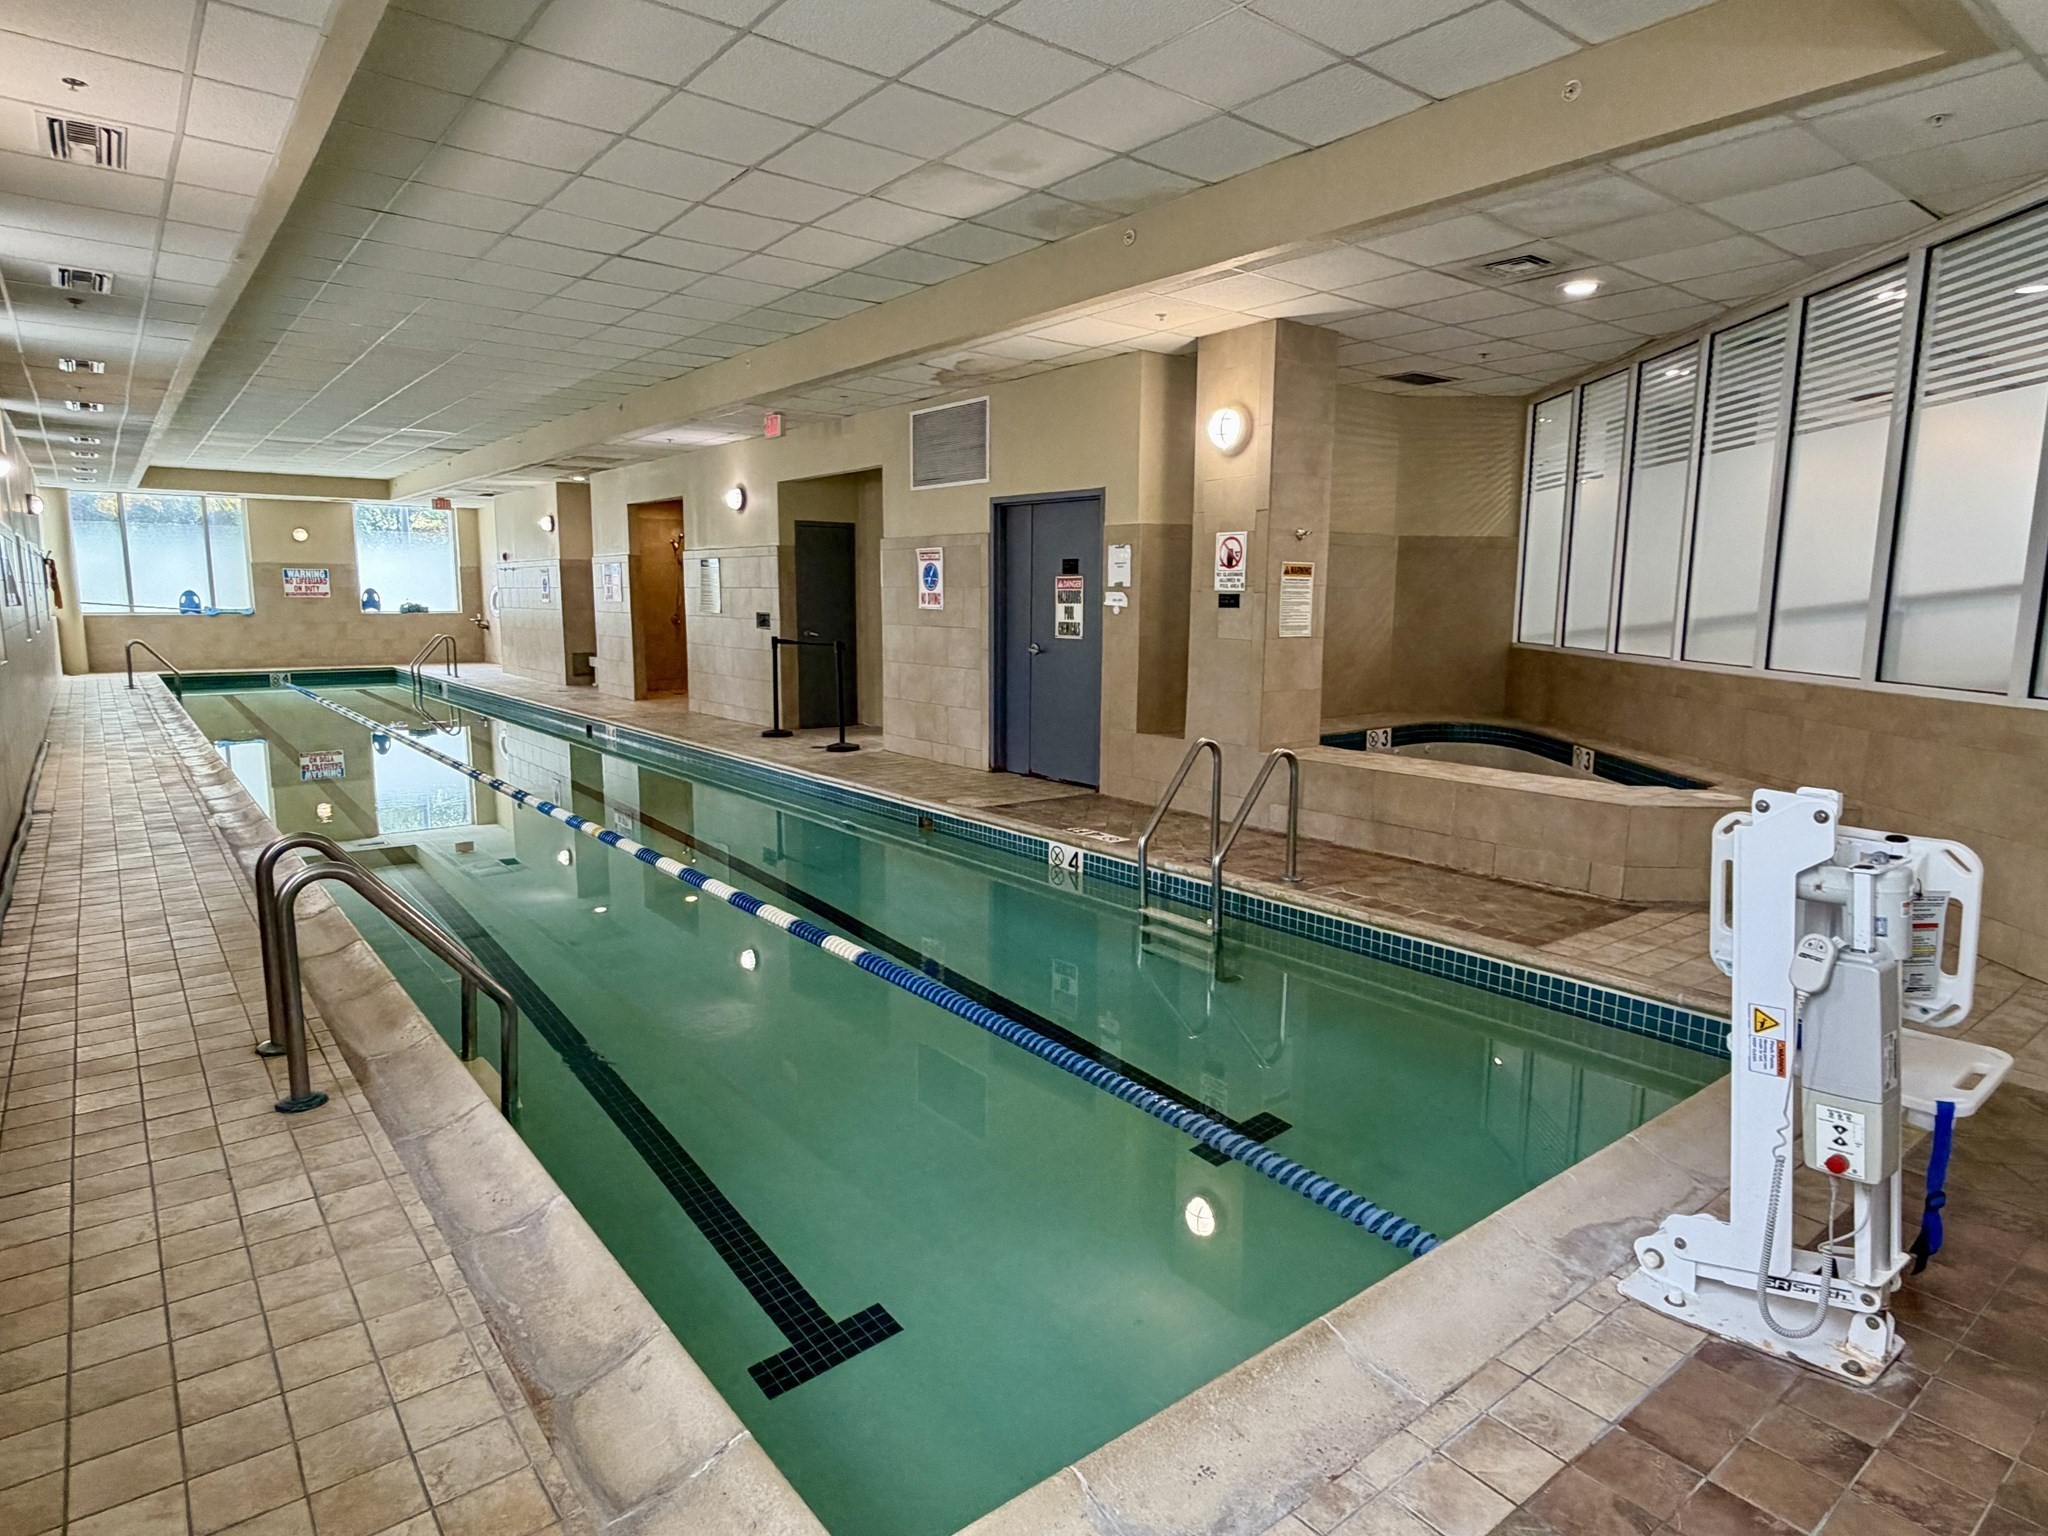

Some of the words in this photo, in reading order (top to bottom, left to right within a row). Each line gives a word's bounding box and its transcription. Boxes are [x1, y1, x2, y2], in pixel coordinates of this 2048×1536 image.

[287, 570, 325, 578] WARNING
[1063, 579, 1082, 588] DANGER
[921, 592, 927, 605] NO
[927, 592, 941, 605] DIVING
[1381, 729, 1389, 747] 3
[1583, 751, 1591, 771] 3
[1068, 851, 1079, 872] 4
[1765, 1278, 1789, 1290] SR
[1792, 1283, 1847, 1300] Smth
